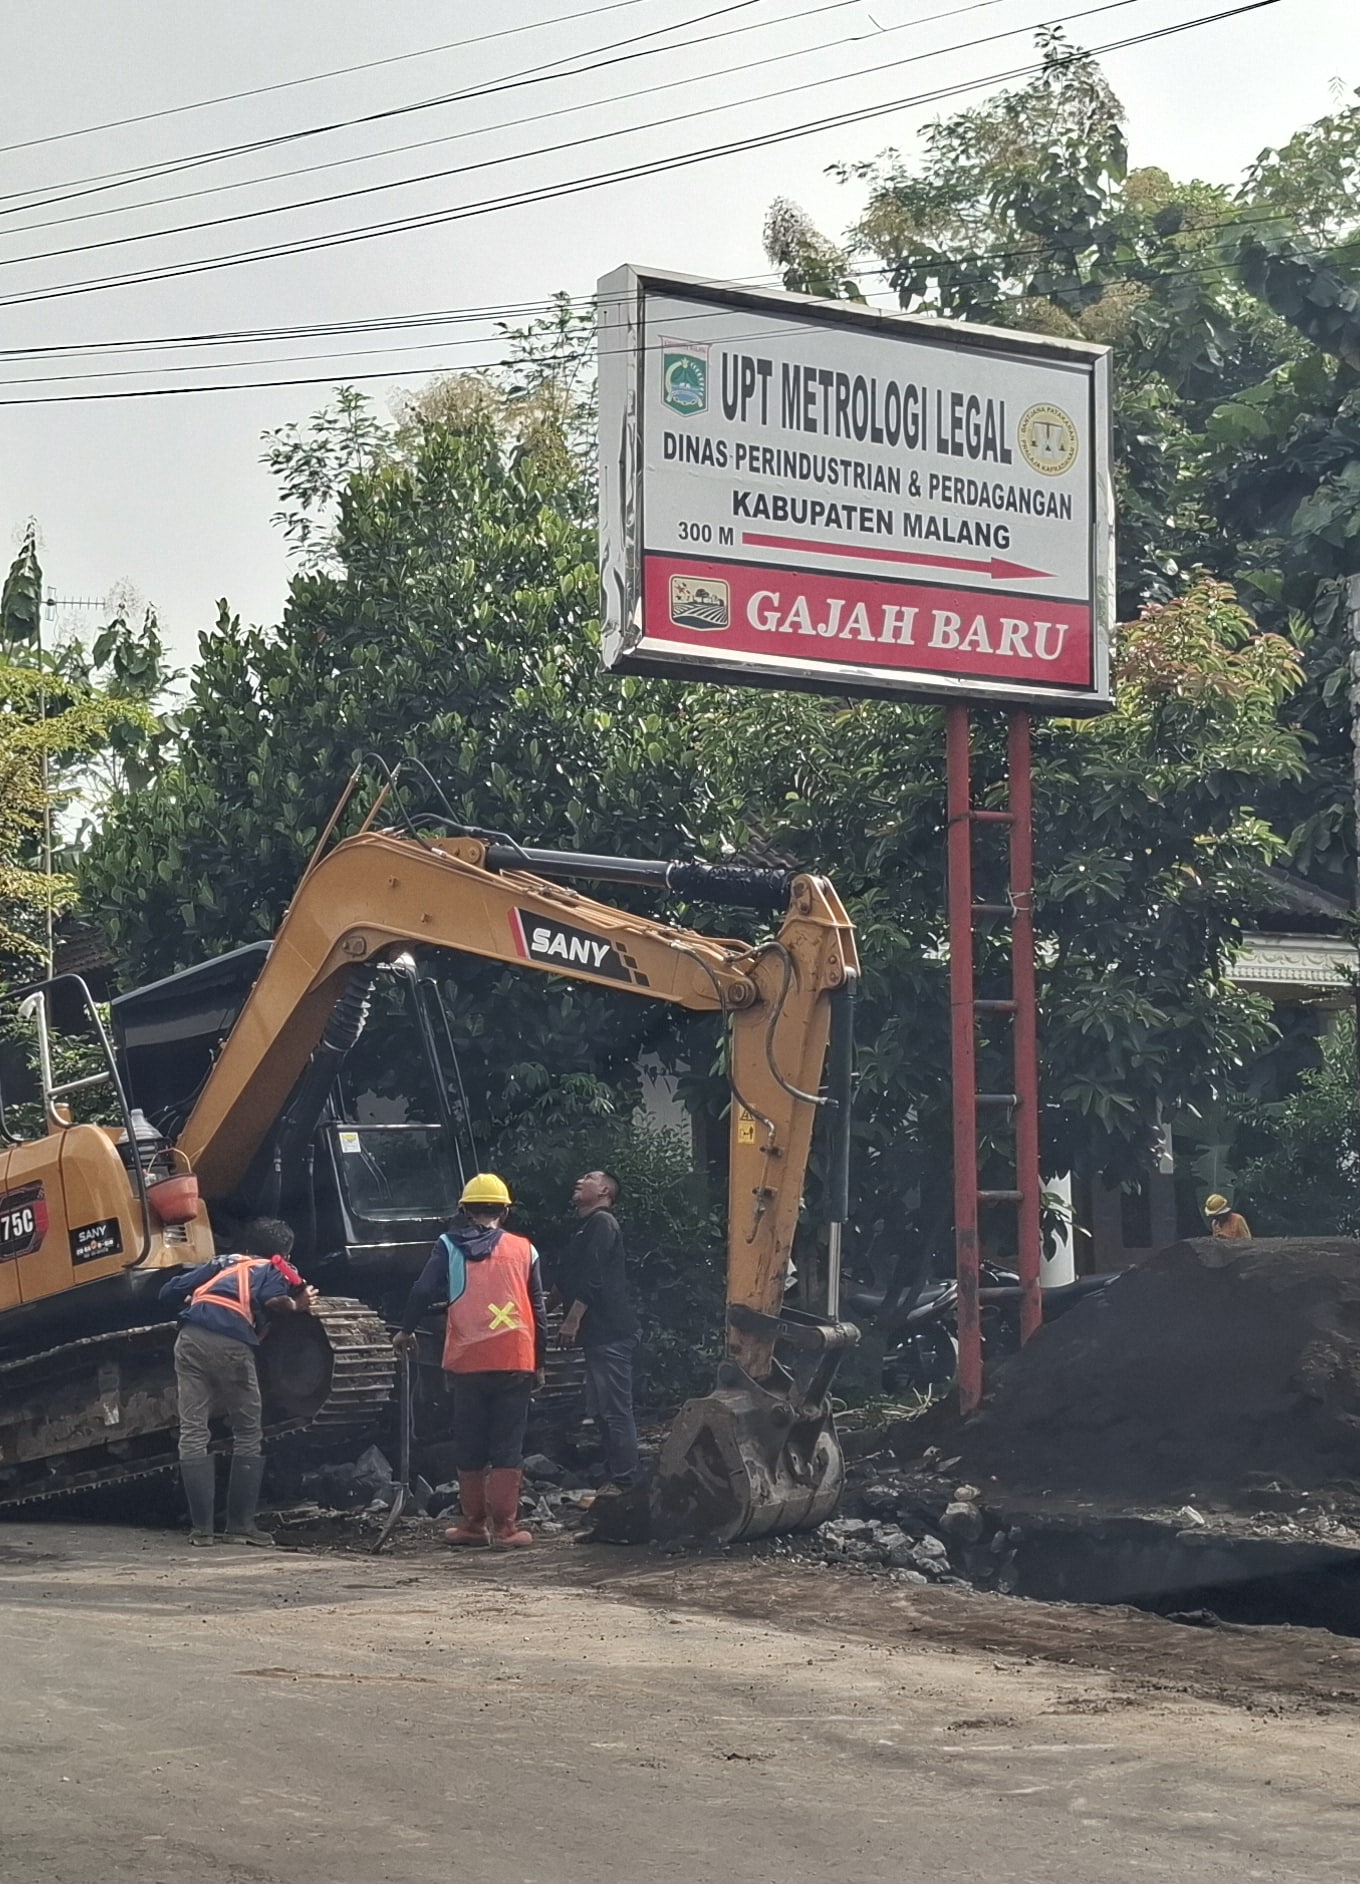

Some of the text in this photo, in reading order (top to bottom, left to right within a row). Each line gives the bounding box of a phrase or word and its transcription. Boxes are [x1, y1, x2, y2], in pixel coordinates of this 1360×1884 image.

[722, 352, 1012, 464] UPT METROLOGI LEGAL
[663, 431, 1072, 520] DINAS PERINDUSTRIAN & PERDAGANGAN
[678, 521, 734, 546] 300 M
[733, 490, 1011, 550] KABUPATEN MALANG
[747, 590, 1070, 661] GAJAH BARU
[531, 927, 610, 968] SANY
[78, 1225, 107, 1243] SANY
